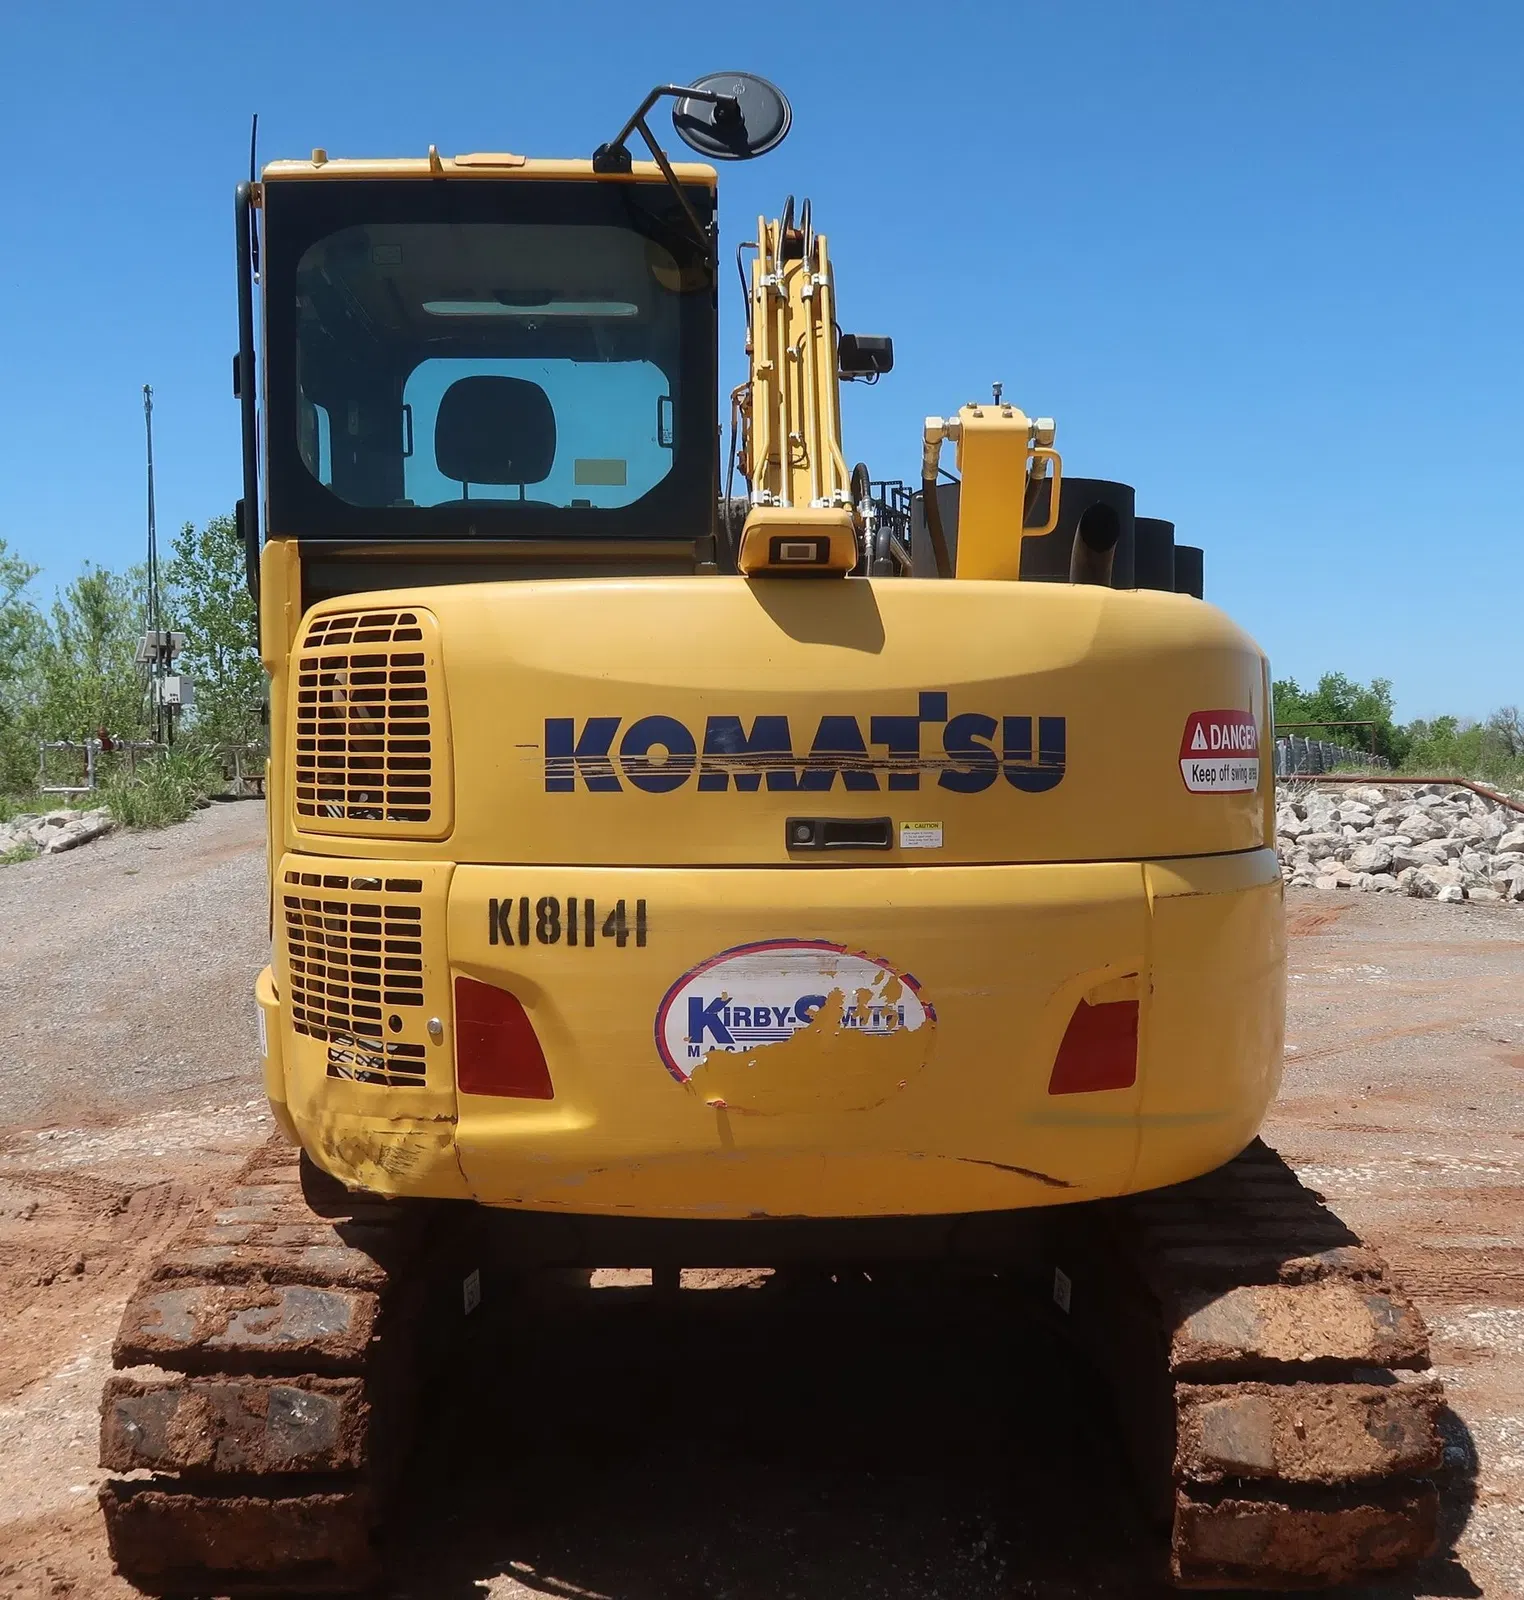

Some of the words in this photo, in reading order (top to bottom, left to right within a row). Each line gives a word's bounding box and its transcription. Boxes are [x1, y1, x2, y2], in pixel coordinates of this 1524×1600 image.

[545, 692, 1066, 793] KOMATSU
[1210, 725, 1256, 750] DANGER
[1192, 764, 1216, 785] Keep
[1219, 764, 1230, 781] off
